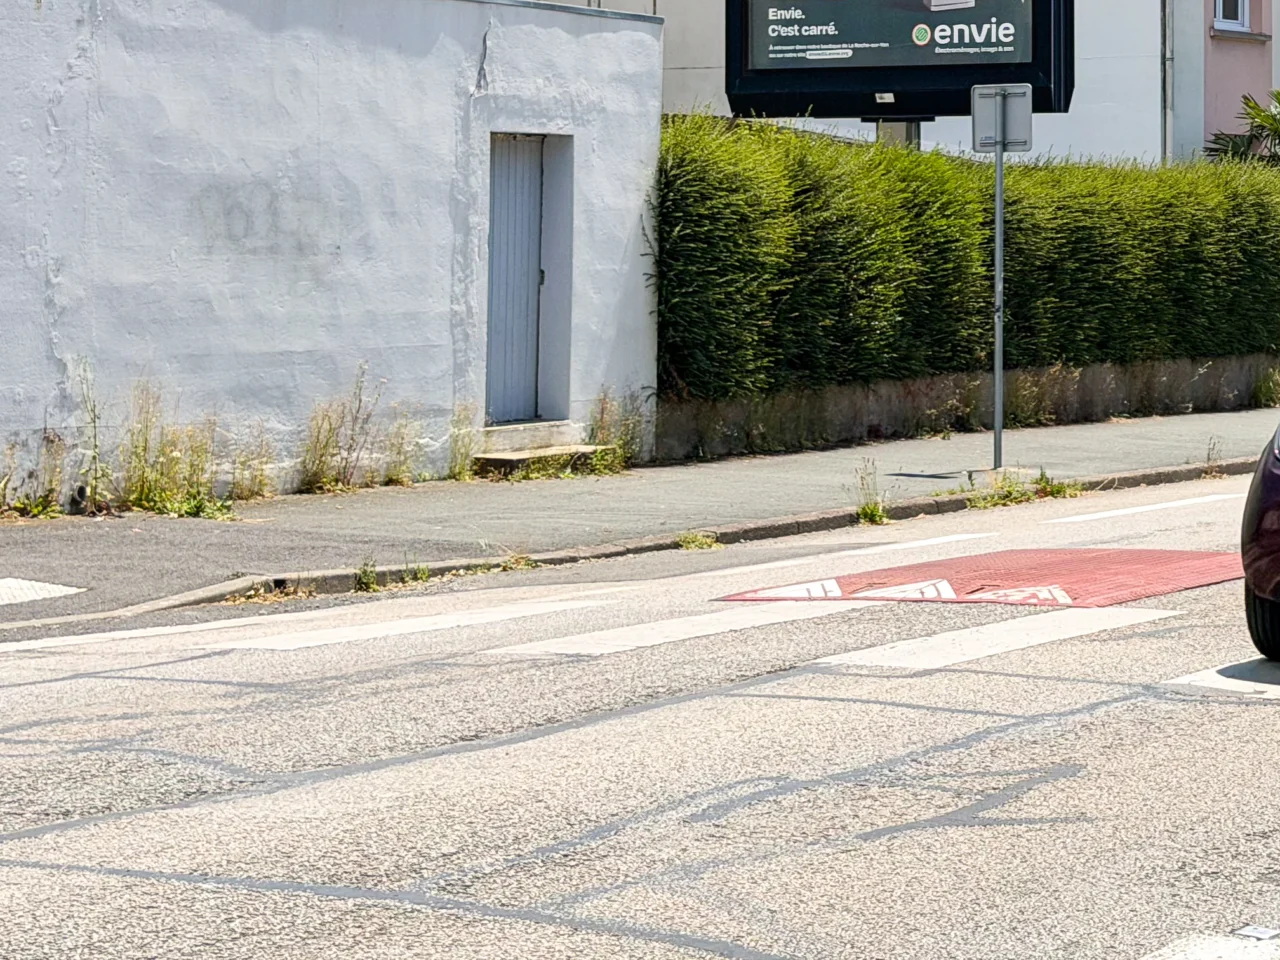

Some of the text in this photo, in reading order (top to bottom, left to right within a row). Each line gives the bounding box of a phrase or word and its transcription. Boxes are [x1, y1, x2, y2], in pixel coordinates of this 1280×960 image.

[768, 7, 805, 20] Envie.
[768, 21, 838, 37] C'est carré.
[934, 17, 1015, 44] envie
